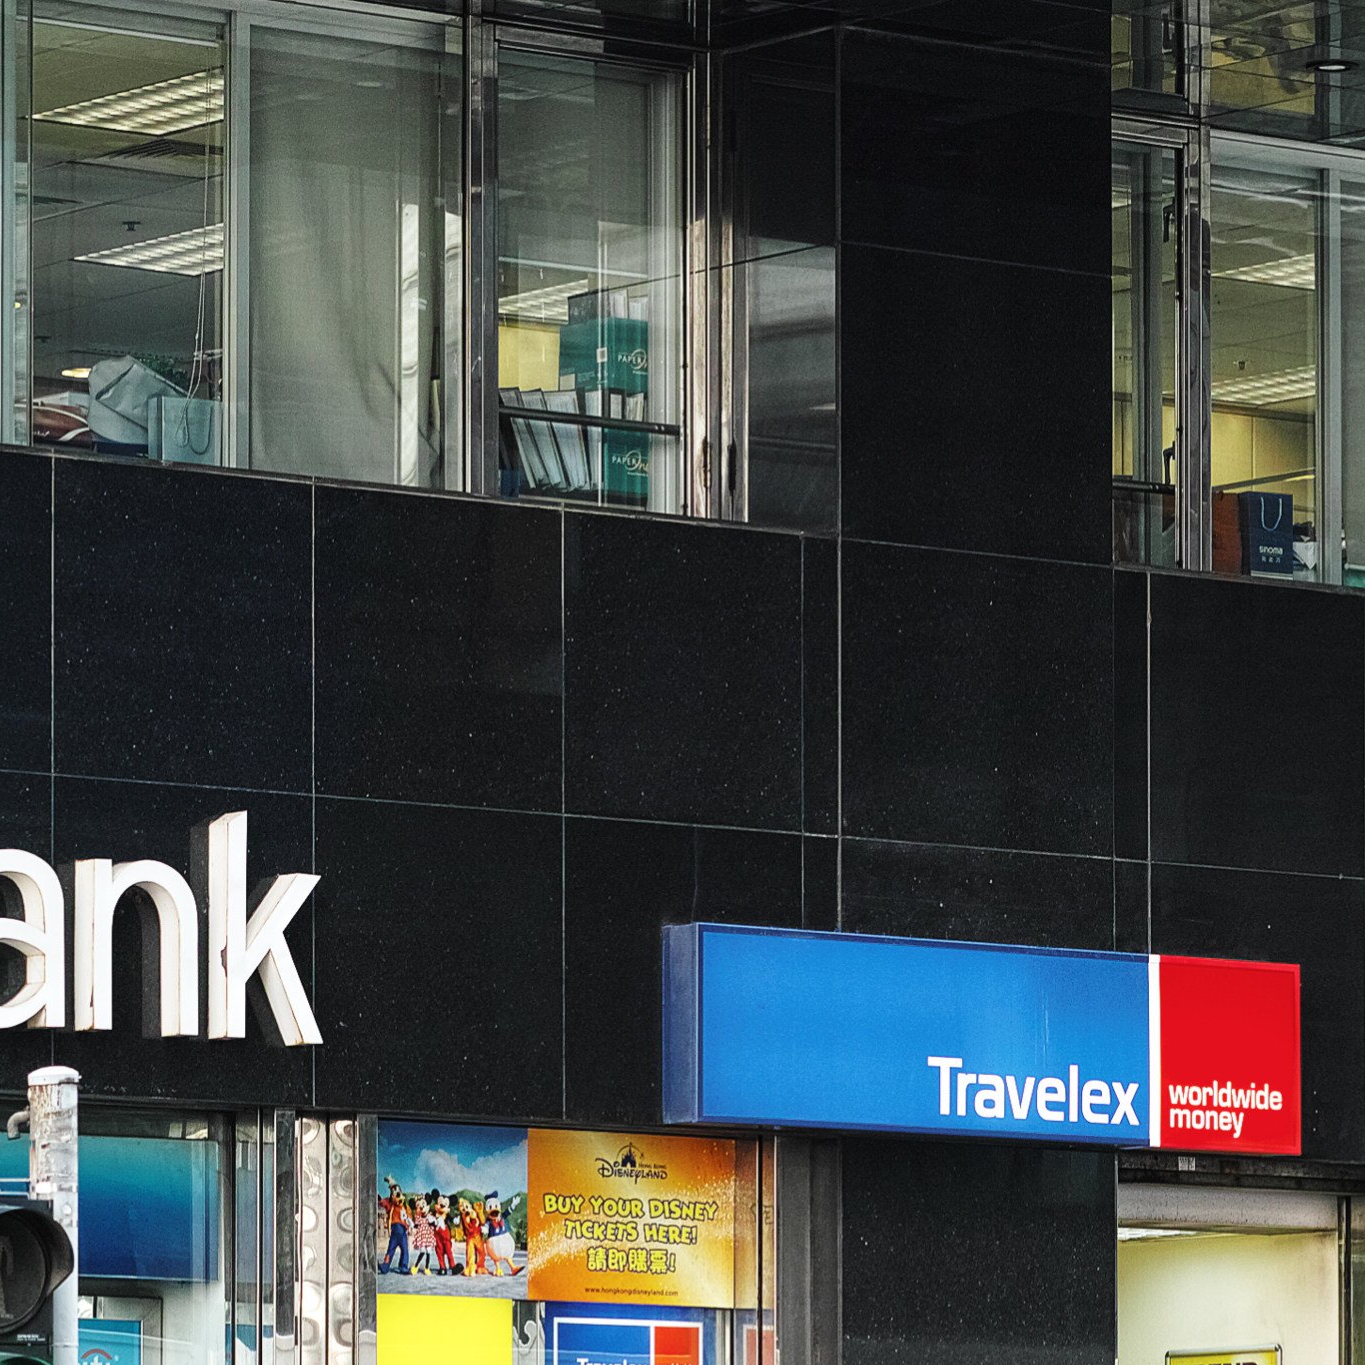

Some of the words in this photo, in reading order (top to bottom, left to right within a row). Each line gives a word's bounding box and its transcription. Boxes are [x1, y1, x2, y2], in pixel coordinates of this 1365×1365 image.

[927, 1057, 1140, 1126] Travelex
[1169, 1081, 1283, 1111] worldwide
[1169, 1109, 1245, 1138] money
[543, 1193, 584, 1215] BUY
[590, 1195, 645, 1219] YOUR
[648, 1199, 718, 1222] DISNEY
[564, 1219, 639, 1242] TICKETS
[643, 1223, 697, 1245] HERE!
[585, 1286, 678, 1297] www.hongkongdisneyland.com
